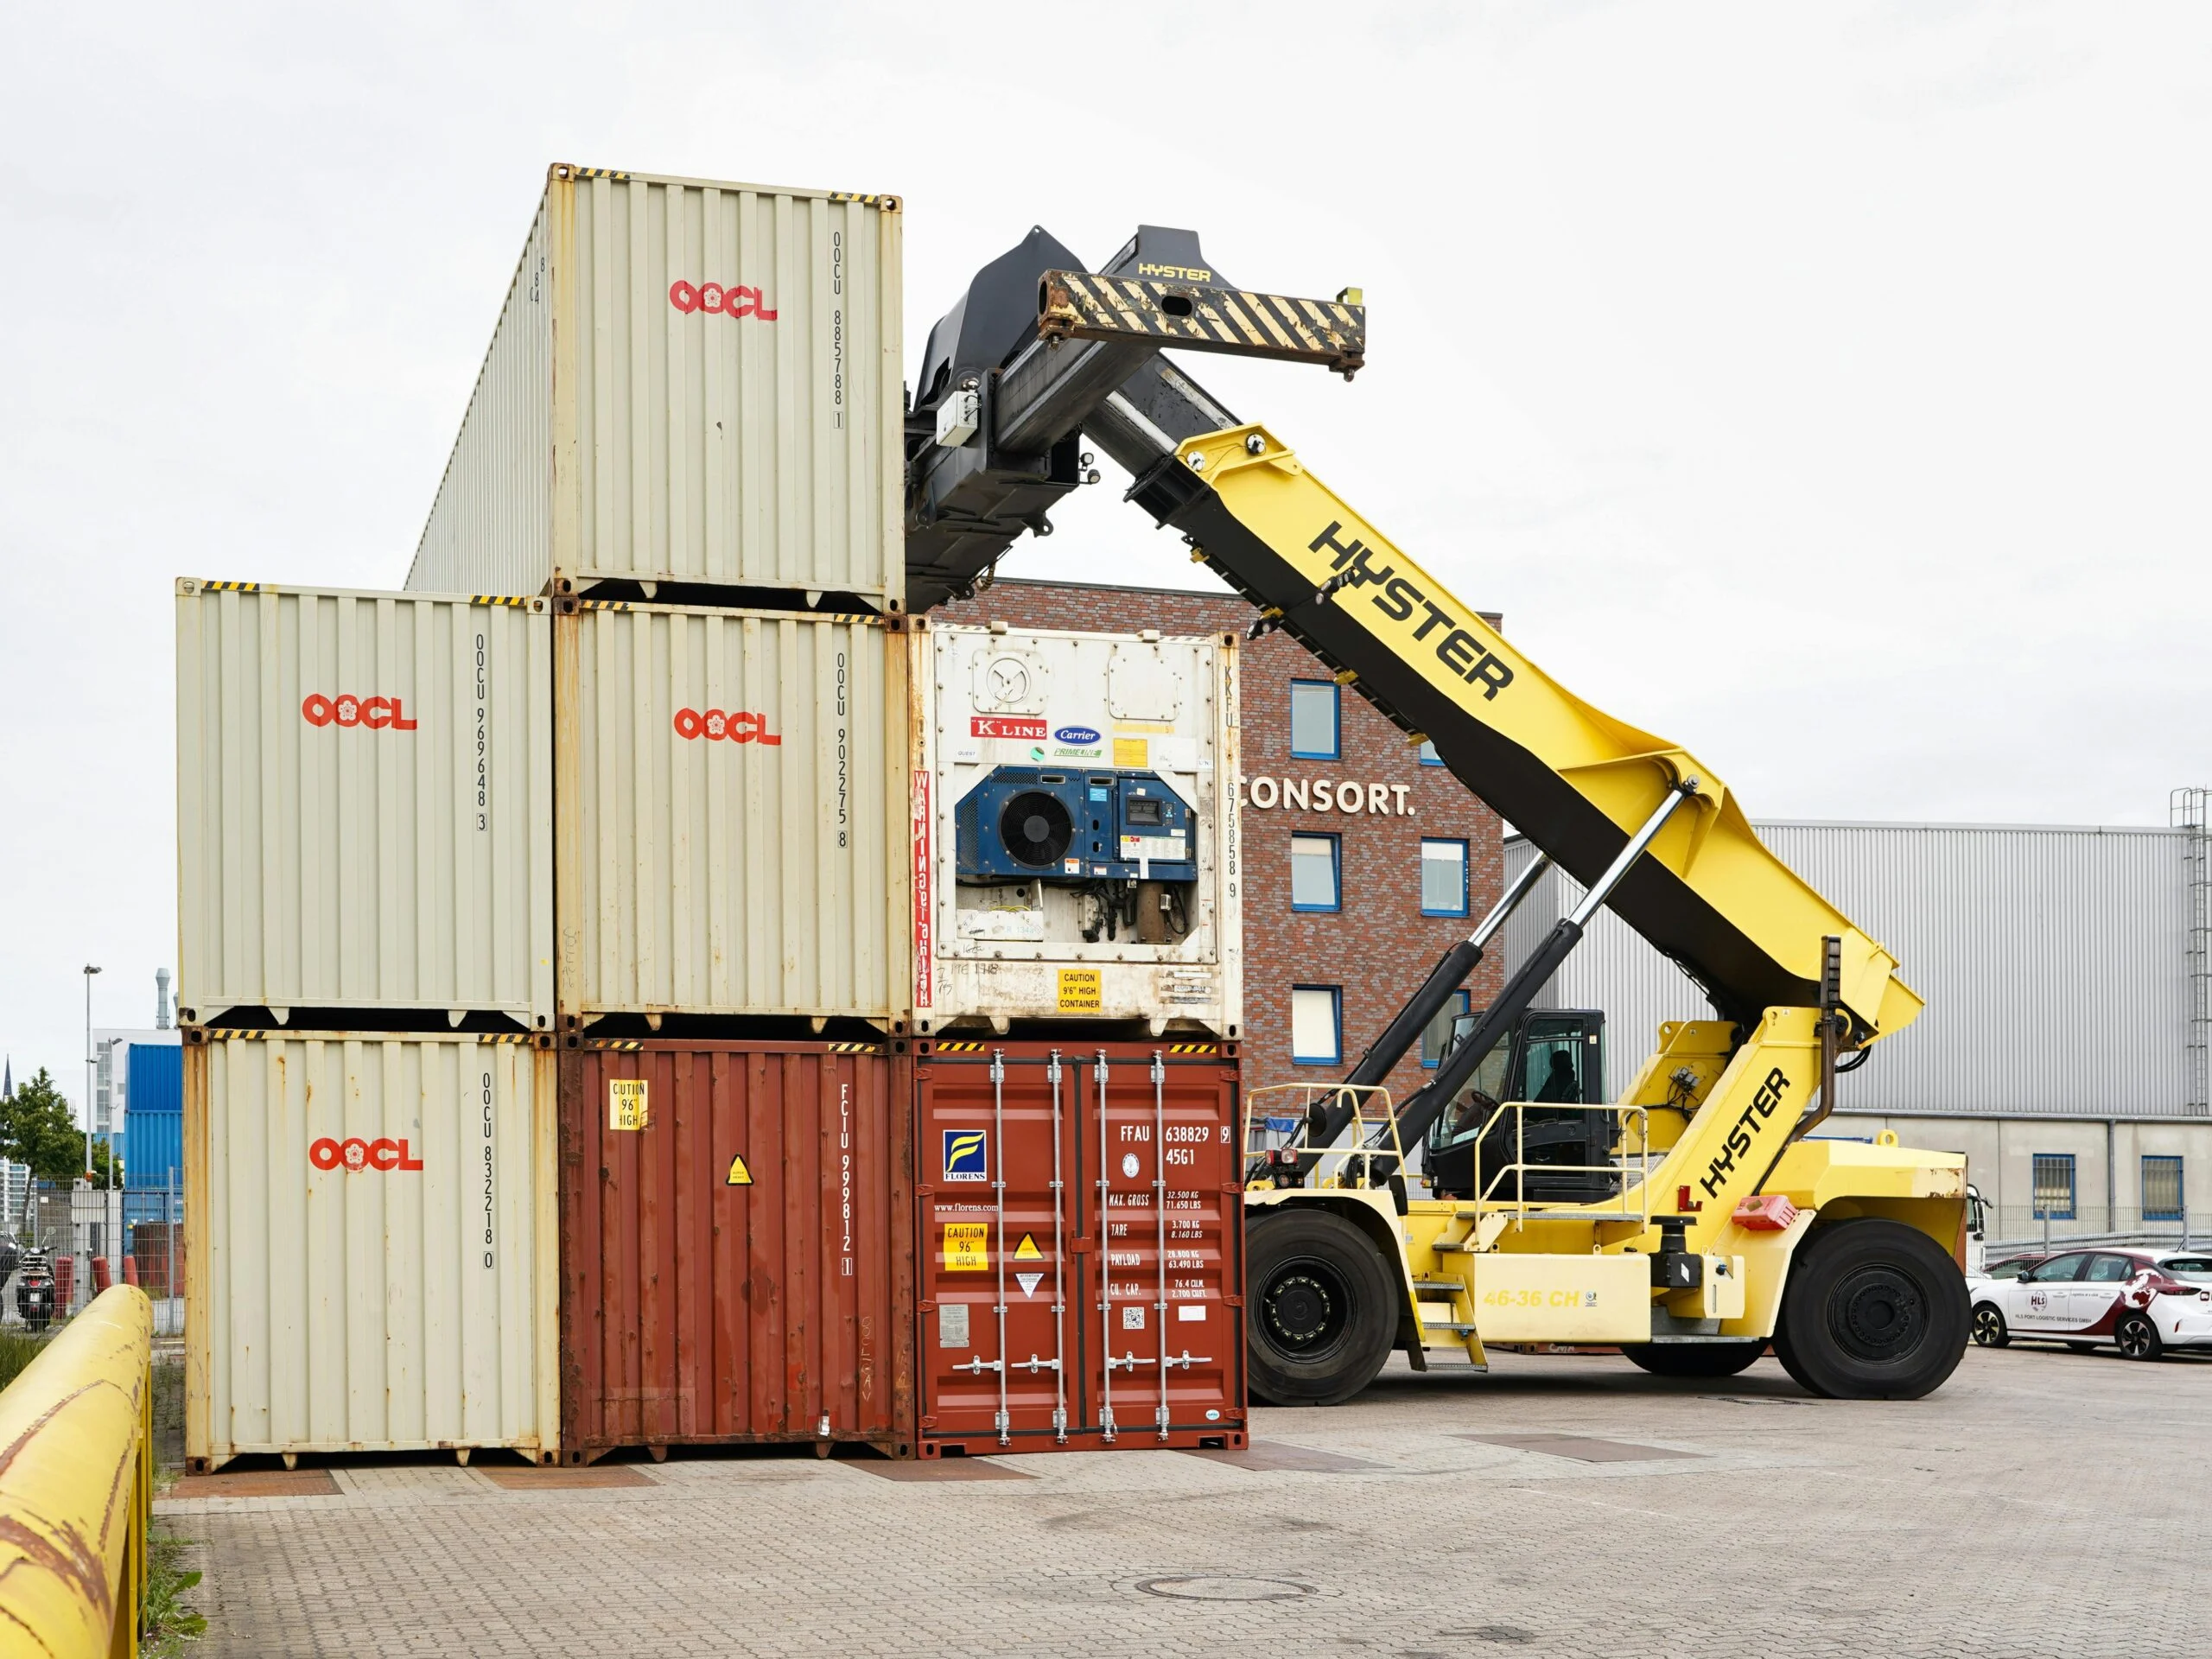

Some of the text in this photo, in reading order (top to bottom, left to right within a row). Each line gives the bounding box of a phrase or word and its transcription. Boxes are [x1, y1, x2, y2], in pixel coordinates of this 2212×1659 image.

[1138, 263, 1211, 283] HYSTER
[670, 279, 778, 321] OOCL
[1307, 520, 1515, 702] HYSTER
[302, 694, 417, 730] OOCL
[674, 708, 781, 746] OOCL
[1001, 726, 1046, 738] LINE
[1060, 729, 1096, 741] Carrier
[477, 708, 486, 807] 969648
[837, 728, 847, 824] 902275
[1224, 666, 1236, 898] KKFU 675858 9
[838, 831, 847, 848] 8
[1064, 974, 1095, 982] CAUTION
[1078, 987, 1096, 995] HIGH
[1059, 999, 1100, 1008] CONTAINER
[1120, 1125, 1230, 1142] FFAU 638829 9
[1699, 1067, 1791, 1199] HYSTER
[308, 1137, 423, 1172] OOCL
[1166, 1148, 1194, 1165] 45G1
[484, 1146, 493, 1245] 832218
[1109, 1193, 1150, 1206] MAX. GROSS
[1166, 1191, 1199, 1199] 32.500 KG
[842, 1155, 850, 1252] 999812
[934, 1203, 999, 1212] www.florens.com
[1166, 1200, 1201, 1209] 71.650 LBS
[1111, 1224, 1128, 1236] TARE
[1172, 1220, 1200, 1229] 3.700 KG
[947, 1227, 984, 1238] CAUTION
[956, 1255, 976, 1267] HIGH
[1110, 1253, 1141, 1266] PAYLOAD
[1168, 1260, 1204, 1268] 63.490 LBS
[1109, 1283, 1141, 1295] CU. CAP.
[1174, 1279, 1190, 1288] 76.4
[1172, 1289, 1190, 1298] 2.700
[1483, 1289, 1580, 1307] 46-36 CH
[2031, 1295, 2045, 1306] HLS
